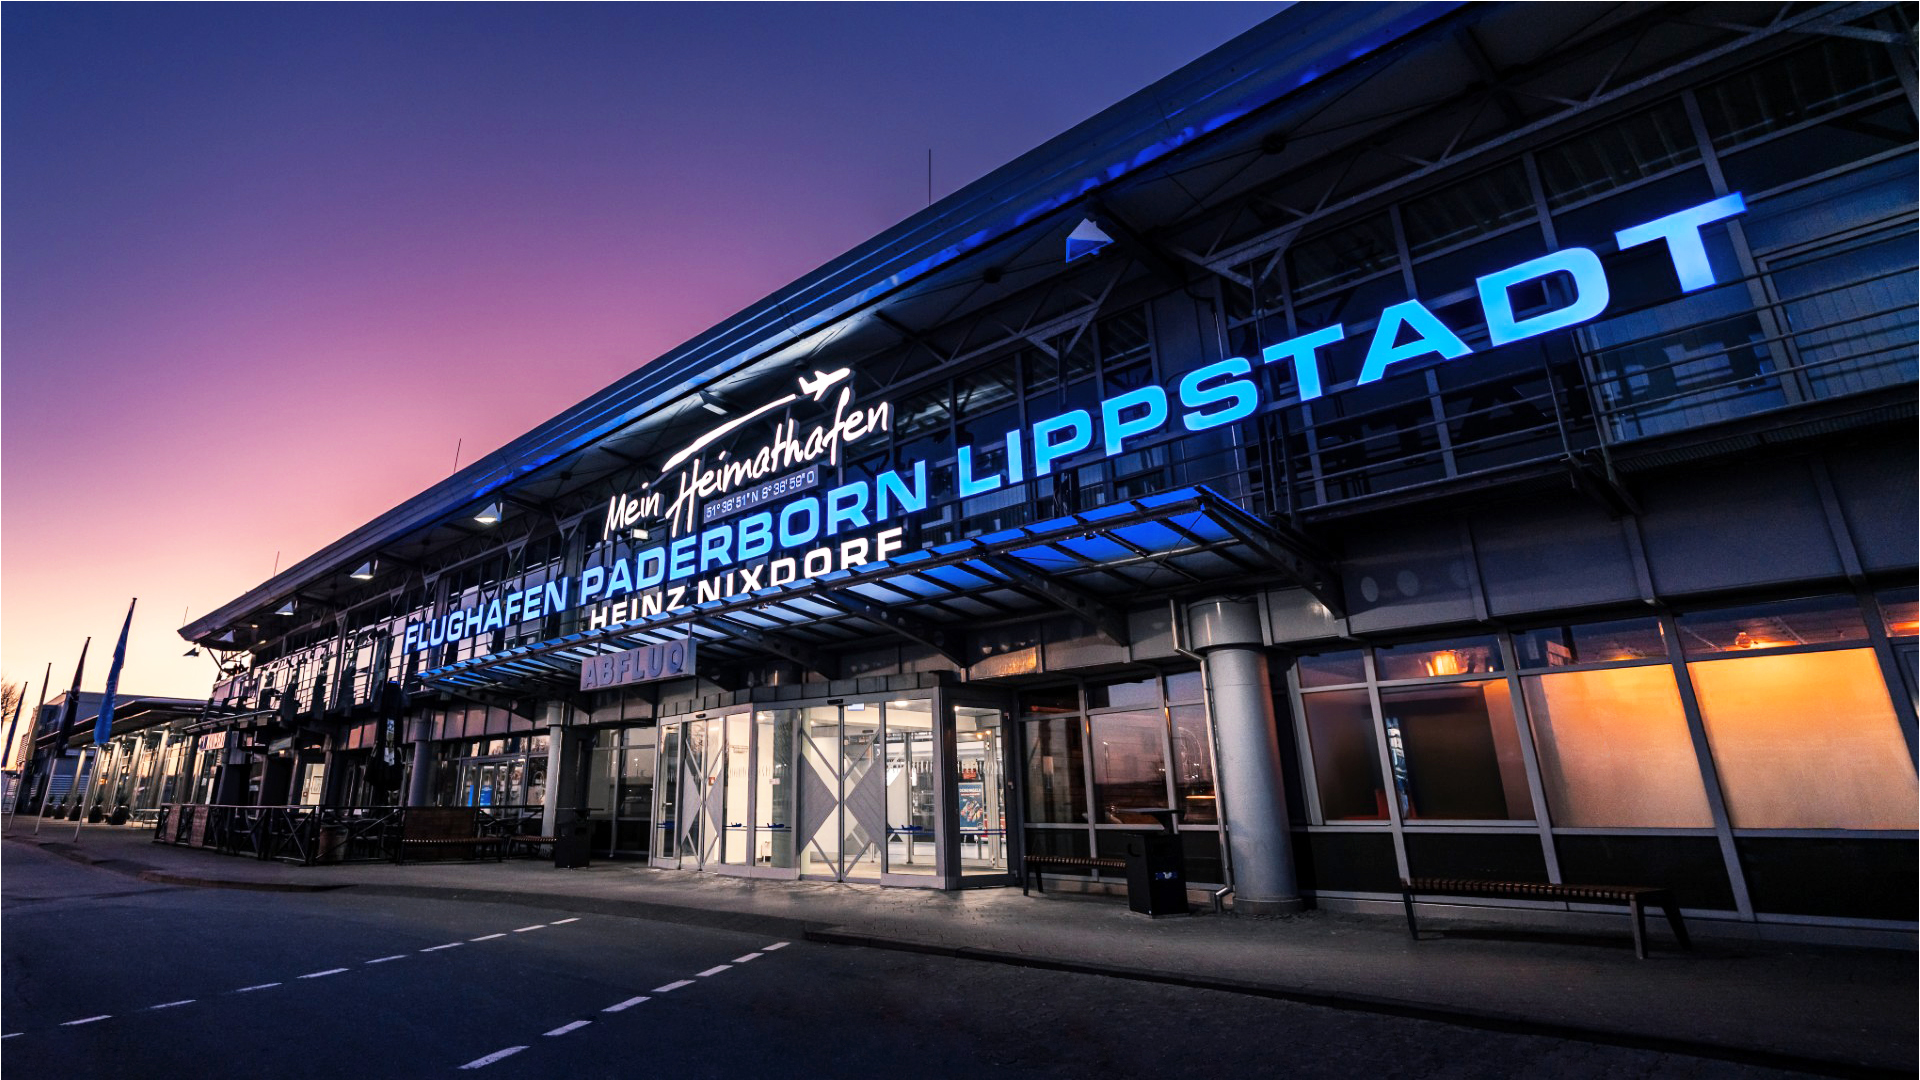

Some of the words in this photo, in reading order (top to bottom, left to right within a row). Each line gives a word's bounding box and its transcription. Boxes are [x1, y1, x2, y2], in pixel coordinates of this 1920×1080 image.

[404, 576, 568, 655] FLUGHAFEN
[581, 459, 927, 605] PADERBORN
[957, 192, 1747, 498] LIPPSTADT
[603, 482, 660, 541] Mein
[665, 386, 889, 538] Heimathafen
[590, 585, 686, 631] HEINZ
[697, 527, 903, 605] NIXDORF
